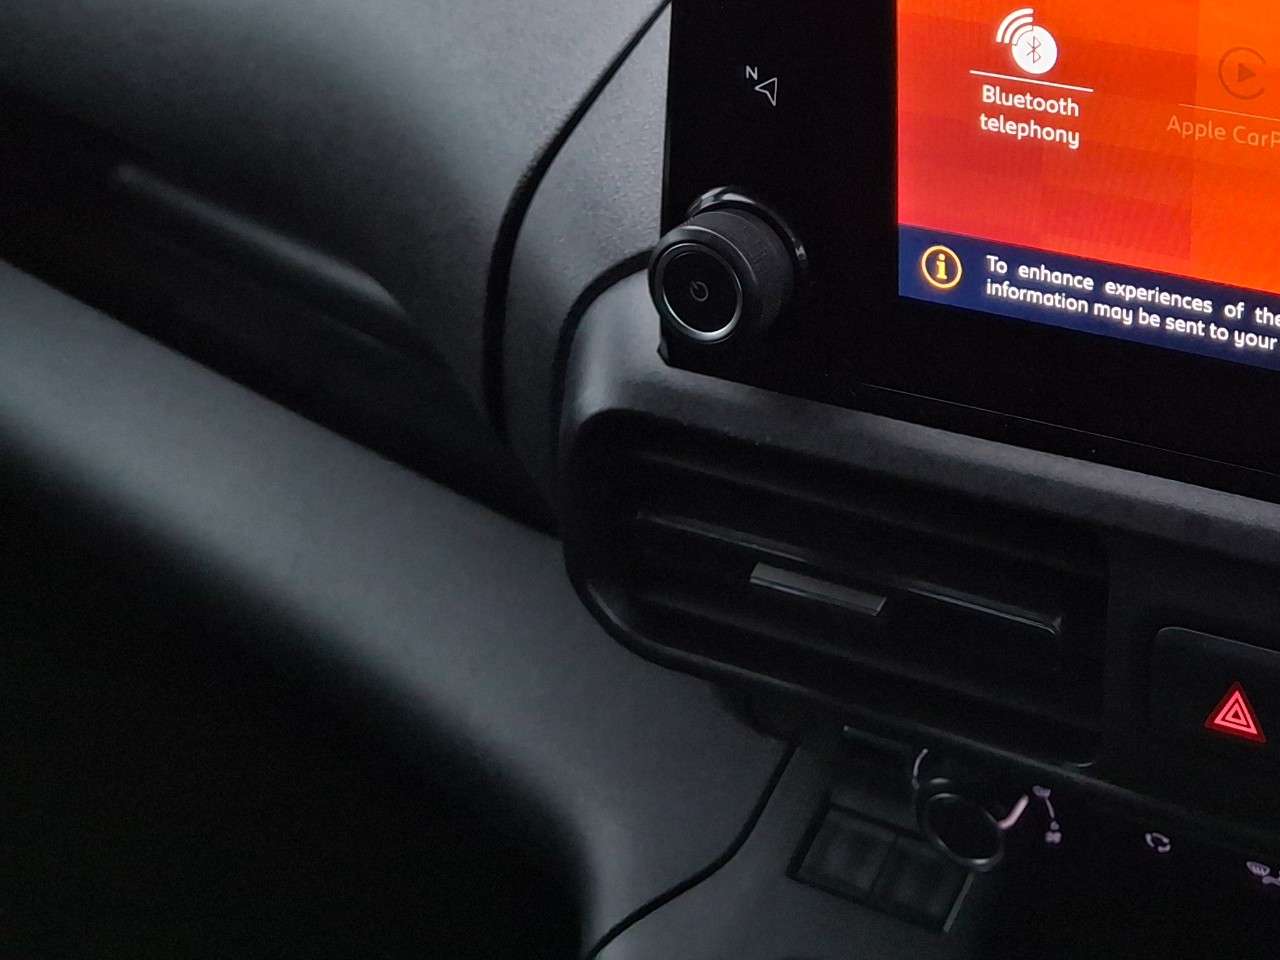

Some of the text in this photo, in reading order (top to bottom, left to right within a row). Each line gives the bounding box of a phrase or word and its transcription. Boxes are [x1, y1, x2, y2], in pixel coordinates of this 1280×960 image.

[745, 64, 758, 81] N
[981, 85, 1080, 117] Bluetooth
[979, 112, 1080, 149] telephony
[1167, 115, 1225, 141] Apple
[986, 254, 1007, 275] To
[1019, 262, 1095, 291] enhance
[1105, 280, 1213, 313] experiences
[1225, 301, 1244, 319] of
[986, 279, 1088, 313] information
[1094, 301, 1134, 326] may
[1139, 308, 1161, 328] be
[1165, 315, 1205, 338] sent
[1209, 322, 1229, 341] to
[1234, 329, 1277, 350] your
